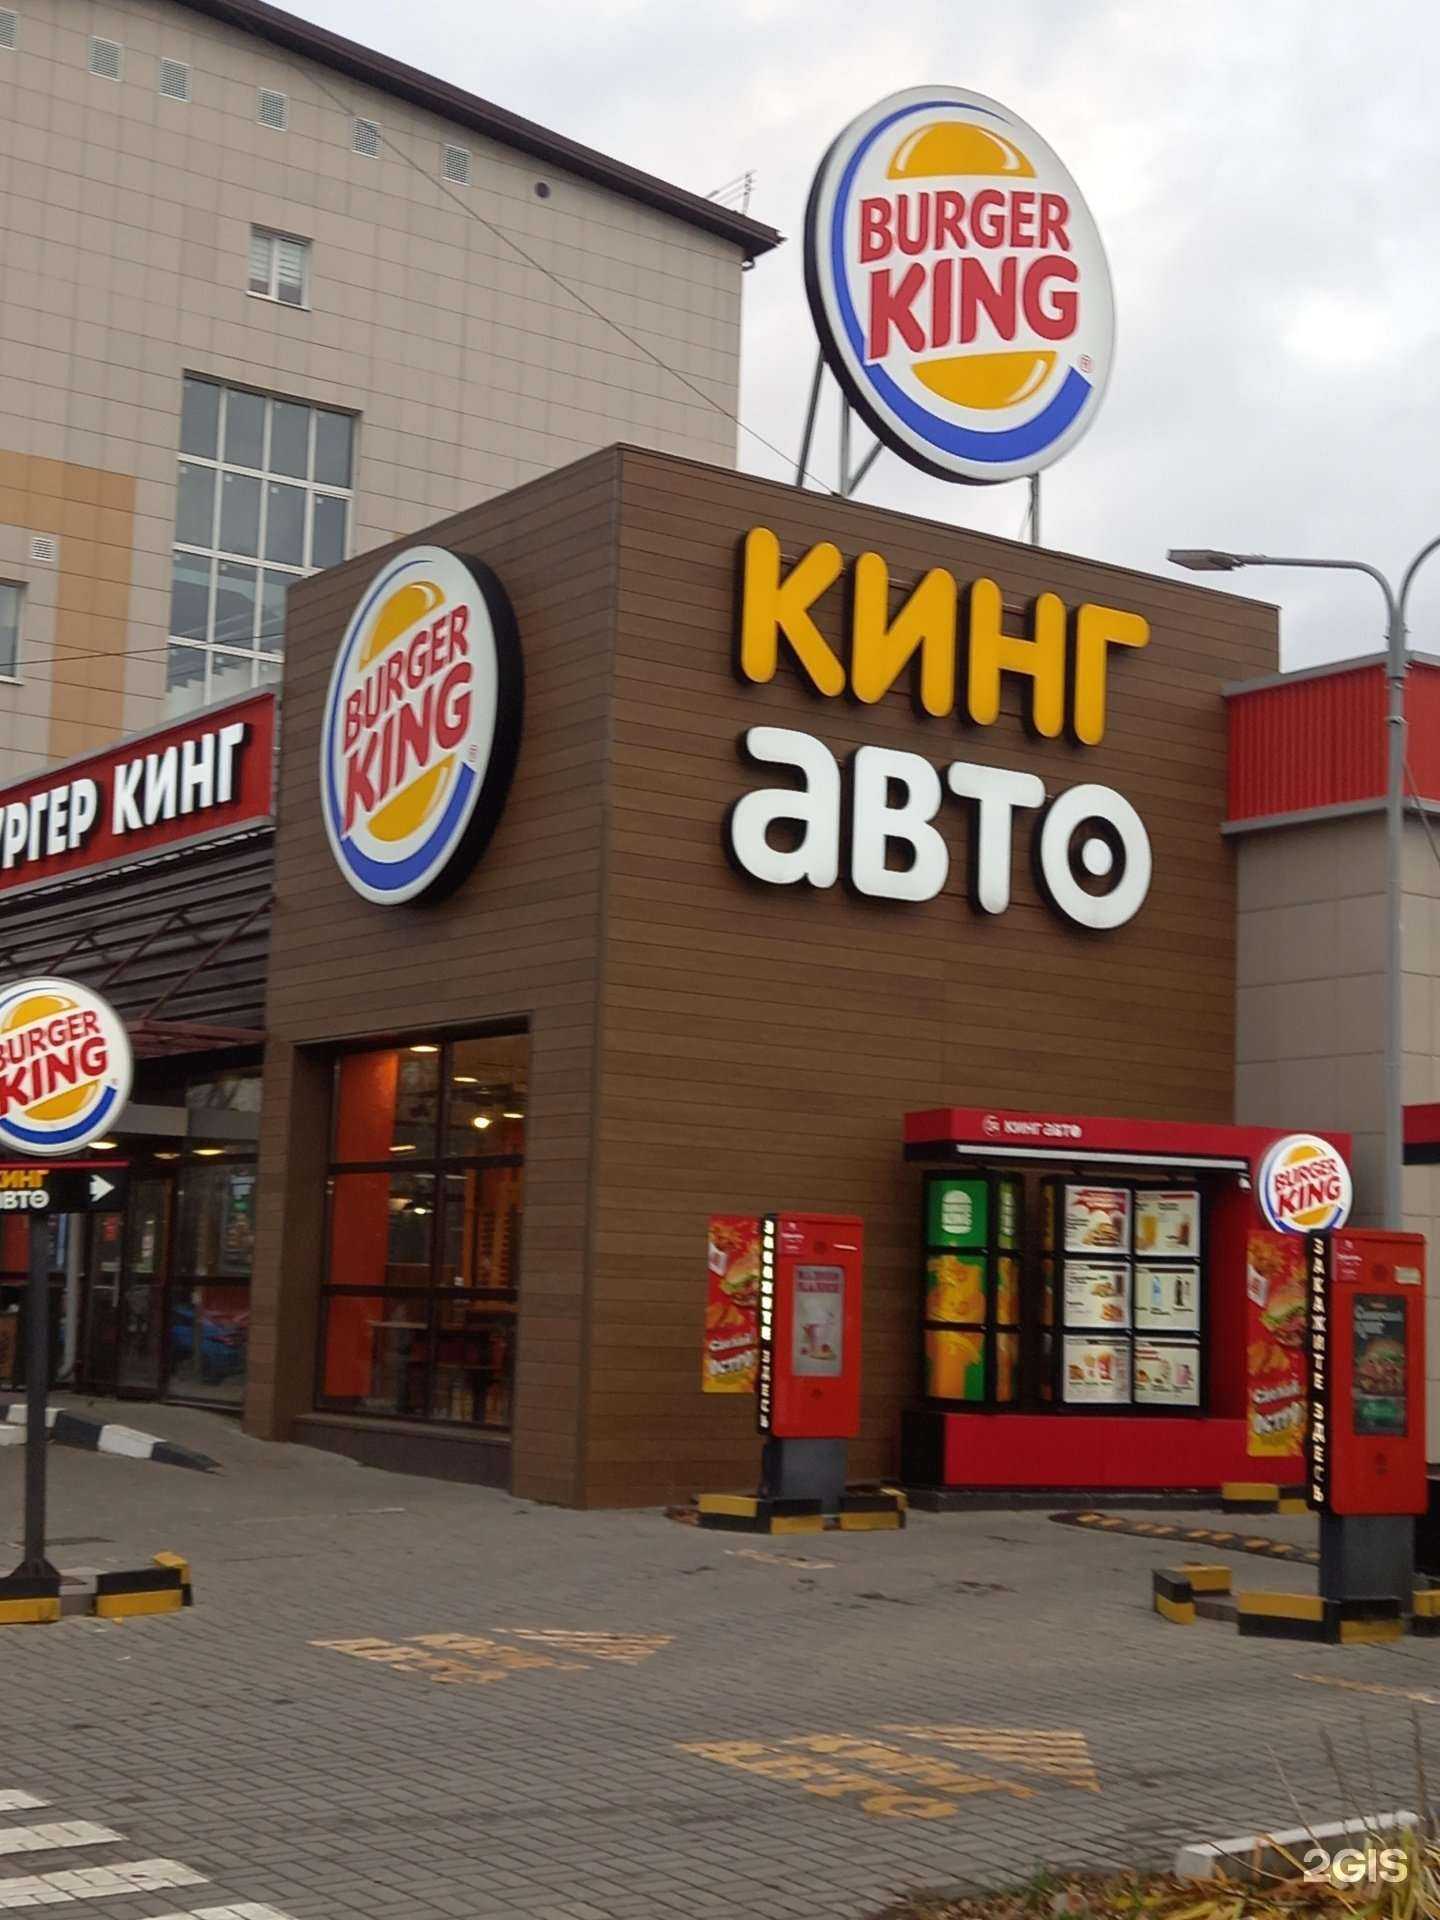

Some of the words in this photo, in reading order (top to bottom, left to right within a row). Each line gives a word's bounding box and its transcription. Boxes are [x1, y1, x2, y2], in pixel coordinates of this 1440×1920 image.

[860, 189, 1070, 264] BURGER
[870, 254, 1079, 359] KING
[345, 605, 469, 754] BURGER
[343, 661, 473, 834] KING
[0, 778, 97, 869] РГЕР
[112, 722, 245, 835] КИНГ
[0, 1036, 108, 1115] KING
[0, 1169, 49, 1188] ИНГ
[0, 1190, 49, 1209] ВТО
[1275, 1158, 1338, 1194] BURGER
[1277, 1176, 1341, 1218] KING
[1312, 1402, 1326, 1502] ЗДЕСЬ
